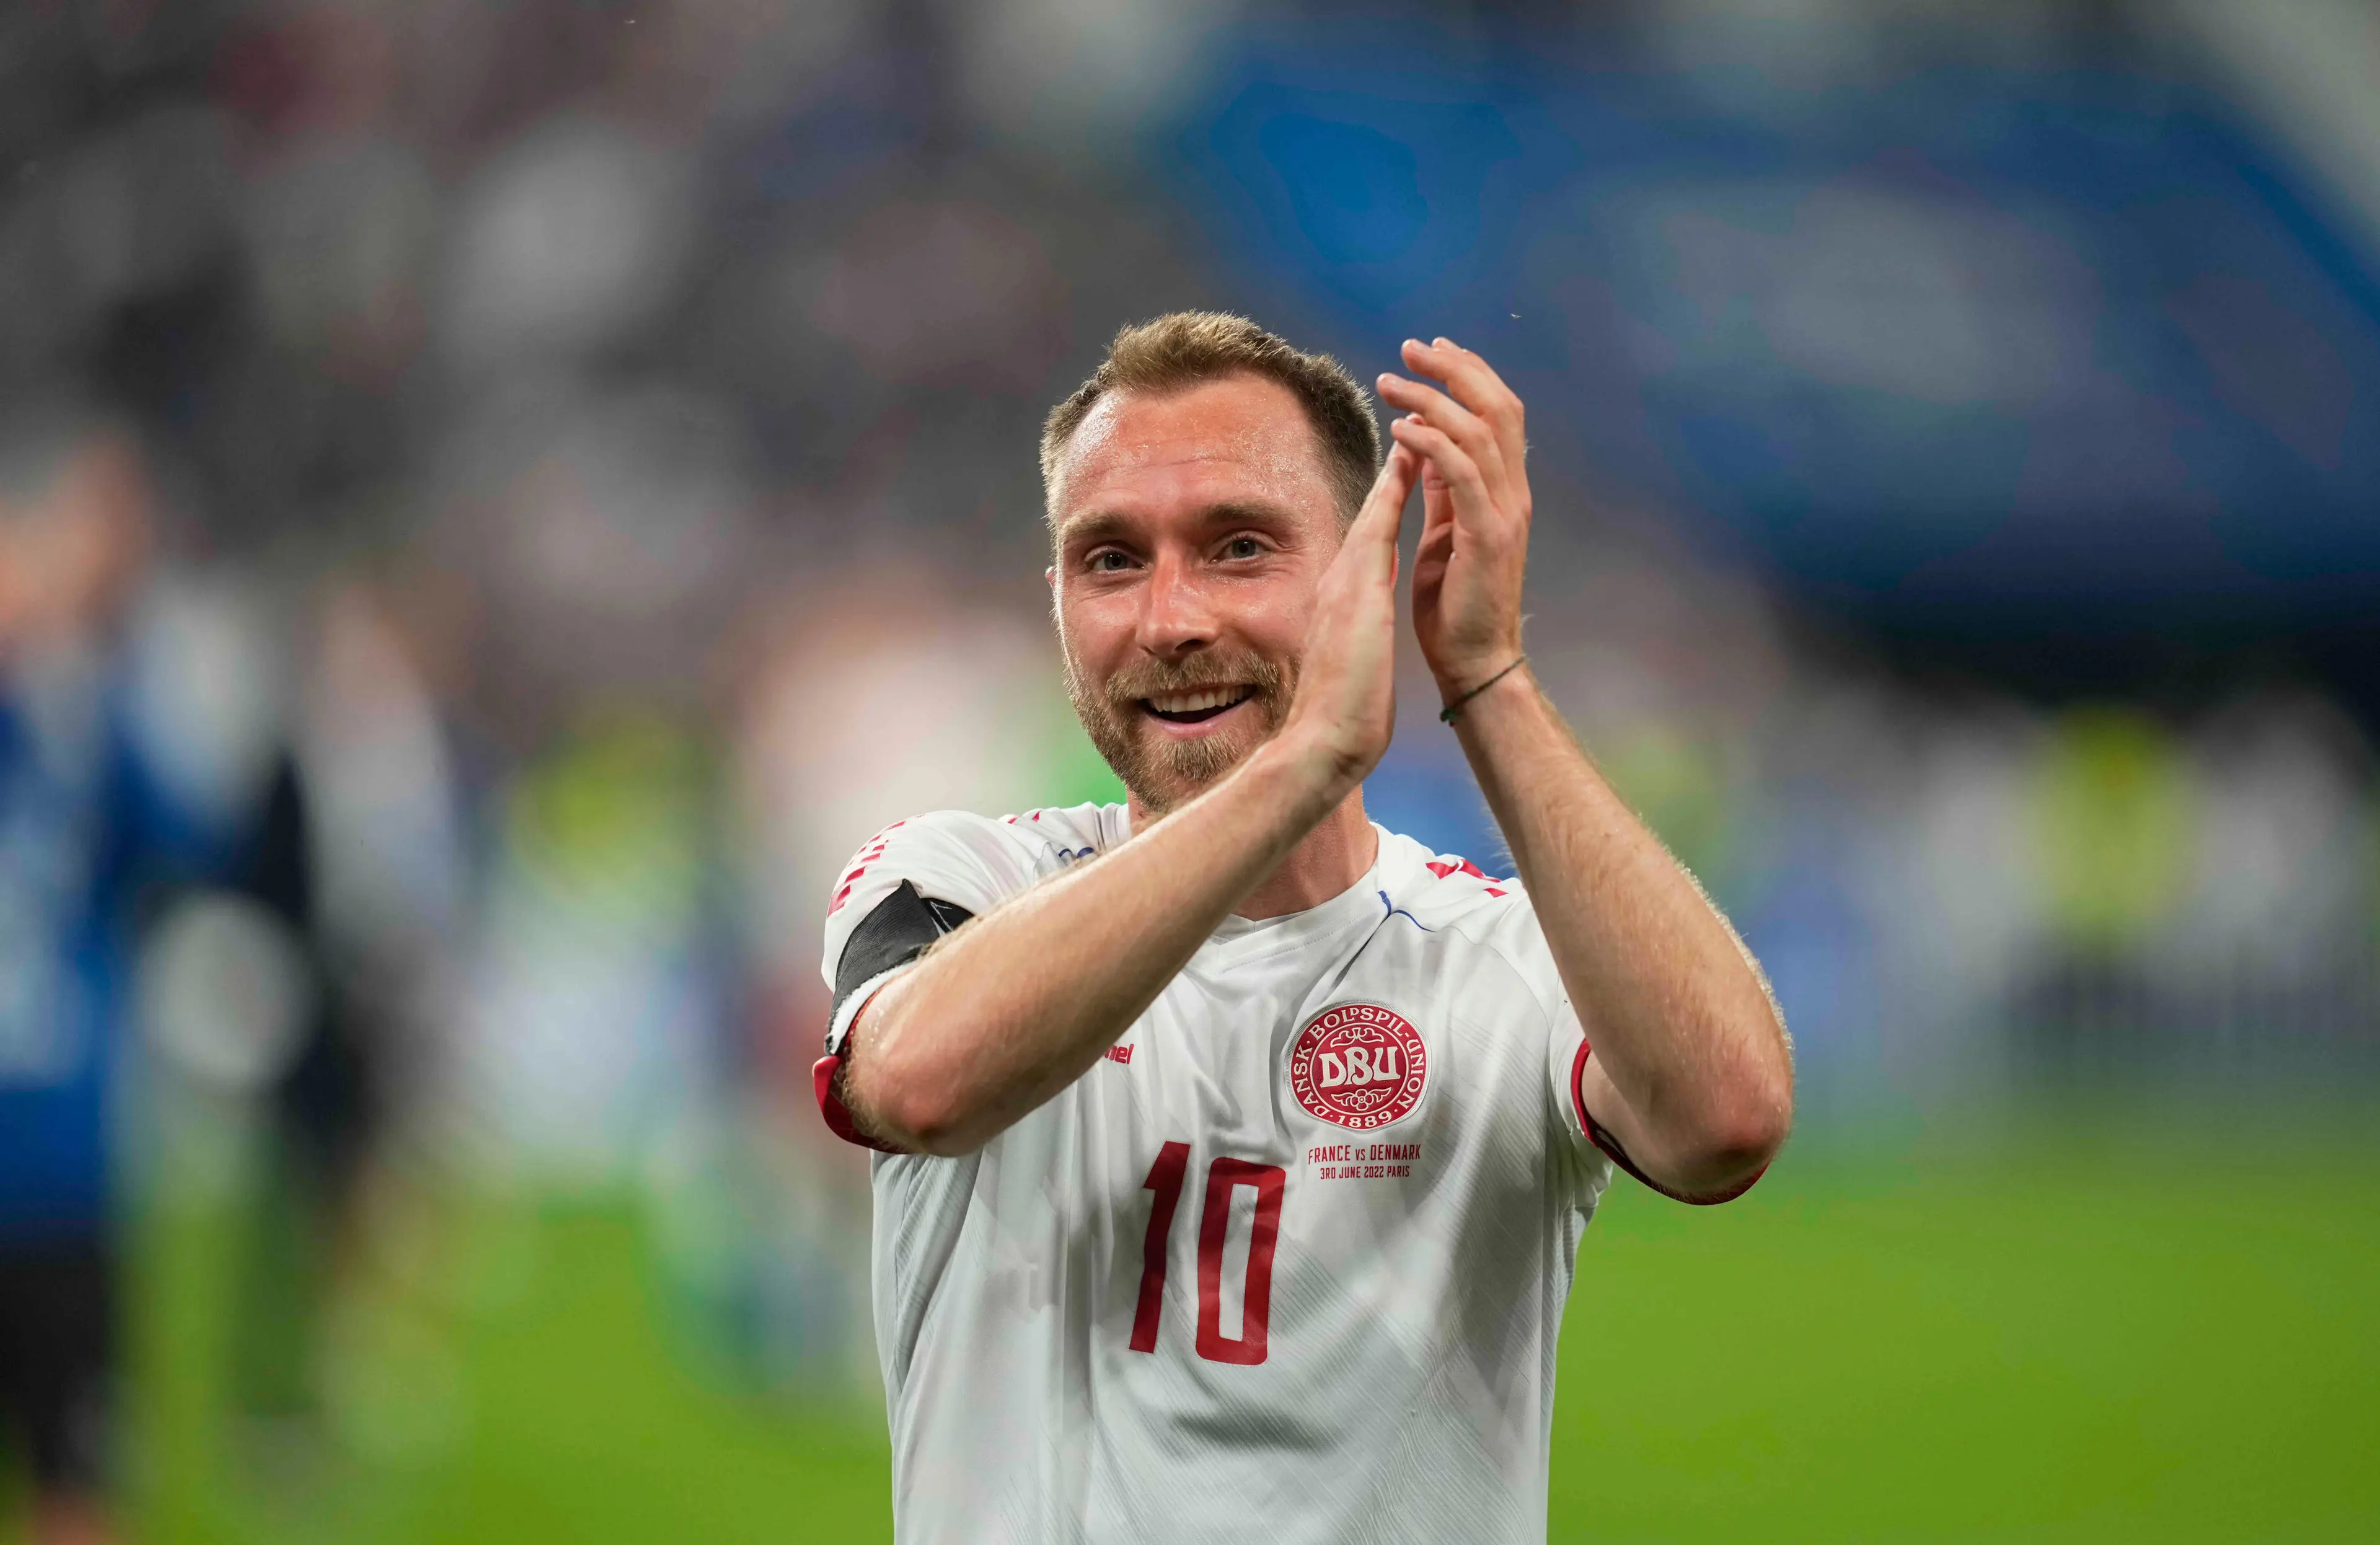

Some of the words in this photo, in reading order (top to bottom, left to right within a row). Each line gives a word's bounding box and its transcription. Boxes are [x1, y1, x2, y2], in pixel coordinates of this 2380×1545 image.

[1294, 1044, 1331, 1117] DANSK
[1318, 1046, 1401, 1088] DBU
[1336, 1110, 1393, 1128] 1889
[1308, 1145, 1351, 1164] FRANCE
[1370, 1144, 1421, 1161] DENMARK
[1320, 1168, 1336, 1179] 3RD
[1339, 1167, 1361, 1178] JUNE
[1364, 1166, 1384, 1177] 2022
[1387, 1165, 1410, 1177] PARIS
[1129, 1141, 1286, 1365] 10
